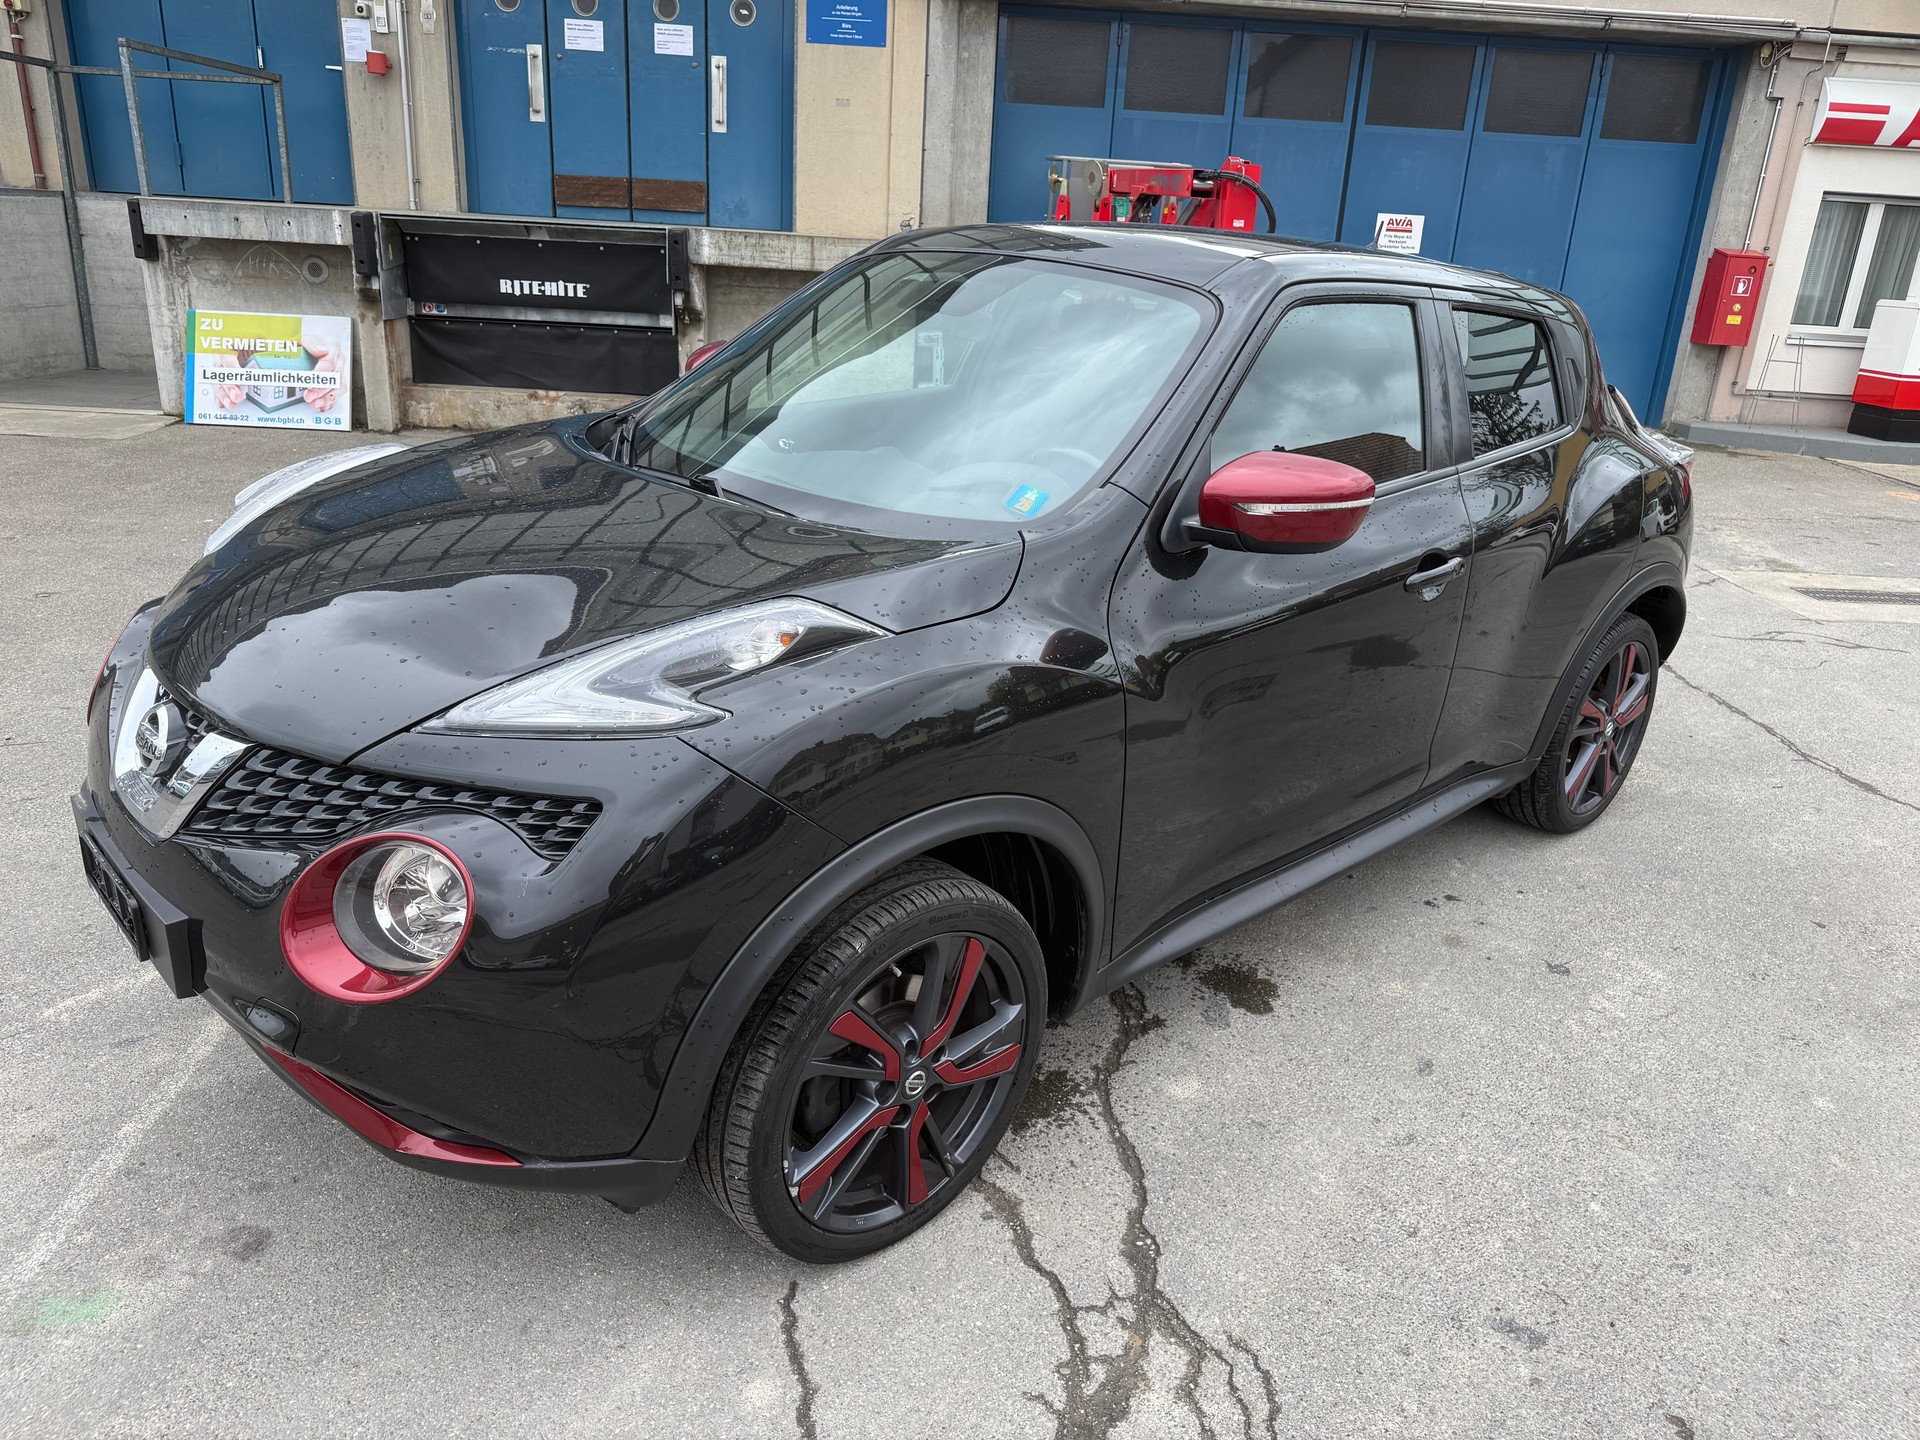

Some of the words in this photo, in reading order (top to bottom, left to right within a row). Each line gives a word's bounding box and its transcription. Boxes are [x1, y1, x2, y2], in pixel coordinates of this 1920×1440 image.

[199, 317, 224, 331] ZU
[200, 336, 298, 353] VERMIETEN
[202, 369, 337, 386] Lagerräumlichkeiten
[198, 412, 212, 420] 061
[257, 416, 305, 425] www.bgbl.ch
